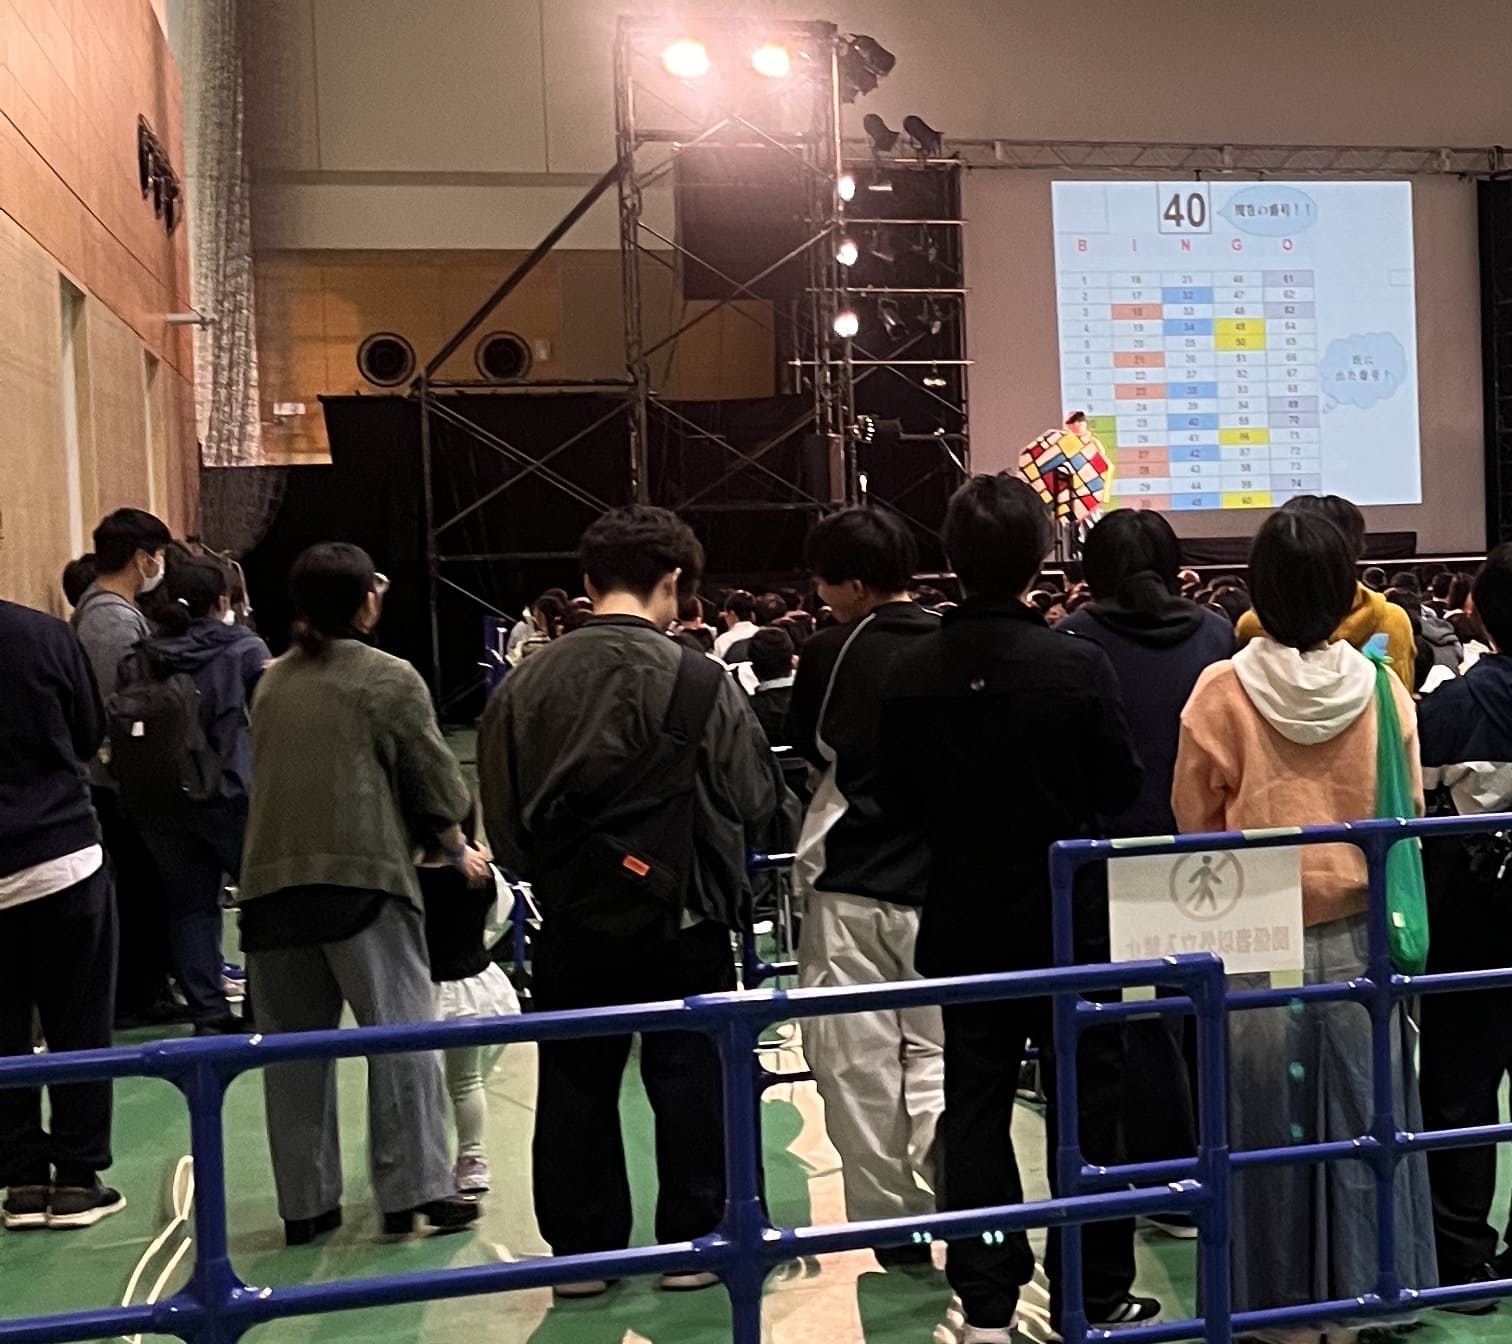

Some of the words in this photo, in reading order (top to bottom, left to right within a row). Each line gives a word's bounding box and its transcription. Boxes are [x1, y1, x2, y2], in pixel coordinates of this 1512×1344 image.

[1163, 192, 1206, 228] 40
[1078, 239, 1087, 251] B
[1181, 239, 1190, 251] N
[1232, 239, 1242, 251] G
[1282, 239, 1293, 251] O
